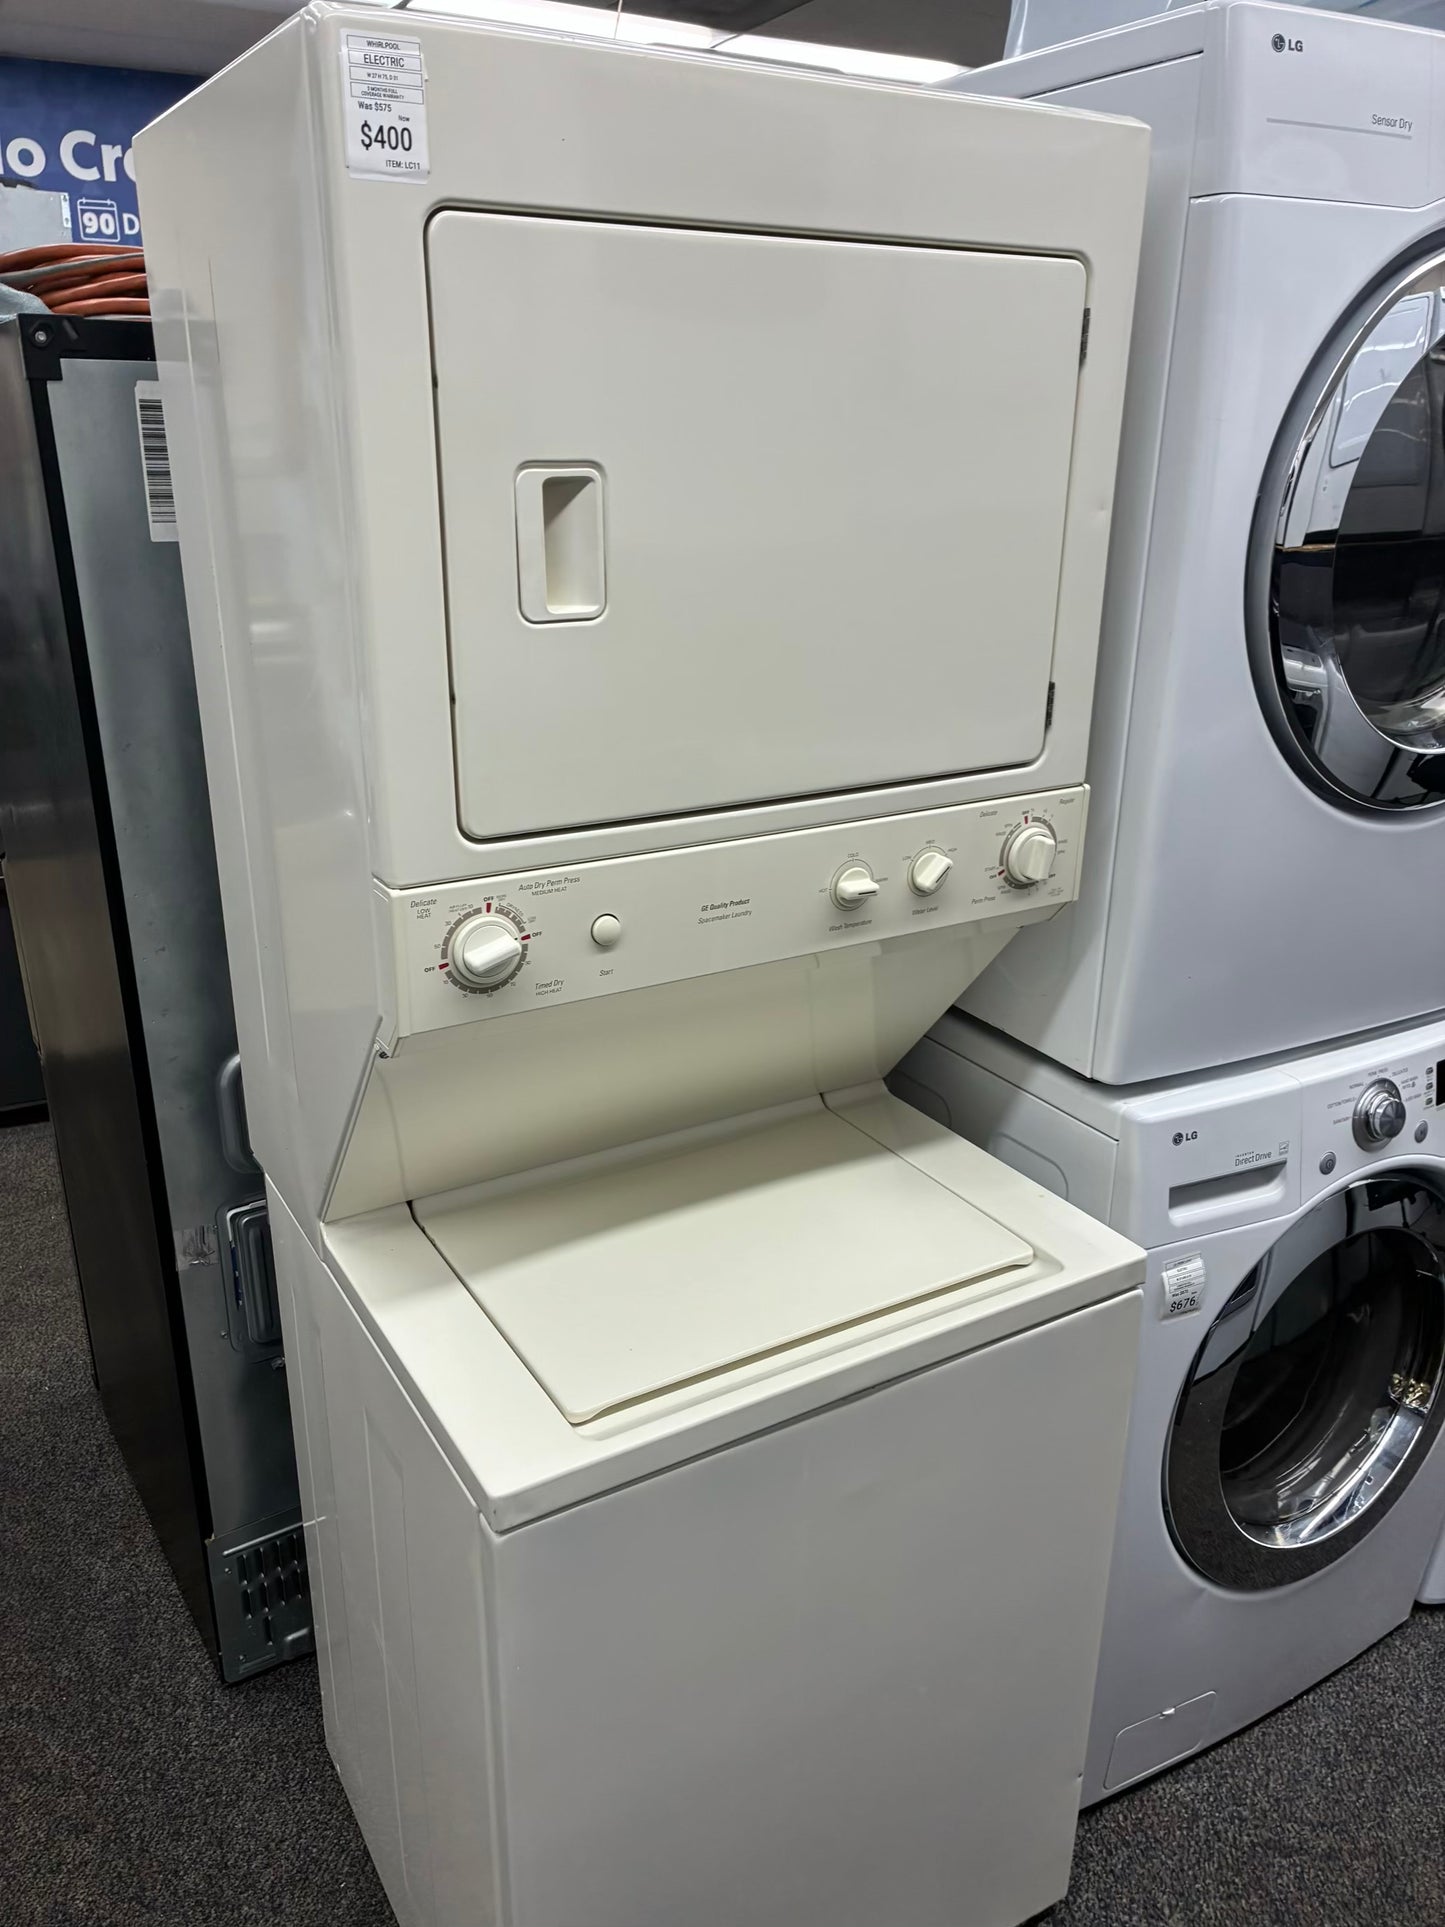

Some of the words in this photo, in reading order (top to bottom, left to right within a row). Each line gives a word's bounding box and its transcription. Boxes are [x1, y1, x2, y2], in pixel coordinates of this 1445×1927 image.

[366, 40, 400, 51] WHIRLPOOL
[1288, 38, 1304, 52] LG
[363, 54, 405, 68] ELECTRIC
[358, 101, 374, 111] Was
[375, 102, 392, 112] $575
[1371, 114, 1398, 129] Sensor
[1399, 118, 1413, 132] Dry
[361, 120, 412, 151] $400
[0, 137, 46, 177] o
[386, 160, 404, 169] ITEM:
[404, 161, 420, 170] LC11
[82, 211, 116, 236] 90
[534, 881, 546, 889] Dry
[546, 879, 562, 887] Perm
[531, 888, 554, 896] MEDIUM
[410, 898, 437, 909] Delicate
[710, 902, 728, 911] Quality
[729, 898, 750, 907] Product
[416, 912, 431, 920] HEAT
[731, 910, 752, 919] Laundry
[599, 968, 615, 977] Start
[535, 980, 552, 991] Timed
[552, 978, 566, 989] Dry
[1185, 1131, 1198, 1142] LG
[1234, 1156, 1255, 1167] Direct
[1255, 1151, 1272, 1162] Drive
[1169, 1296, 1196, 1313] $676
